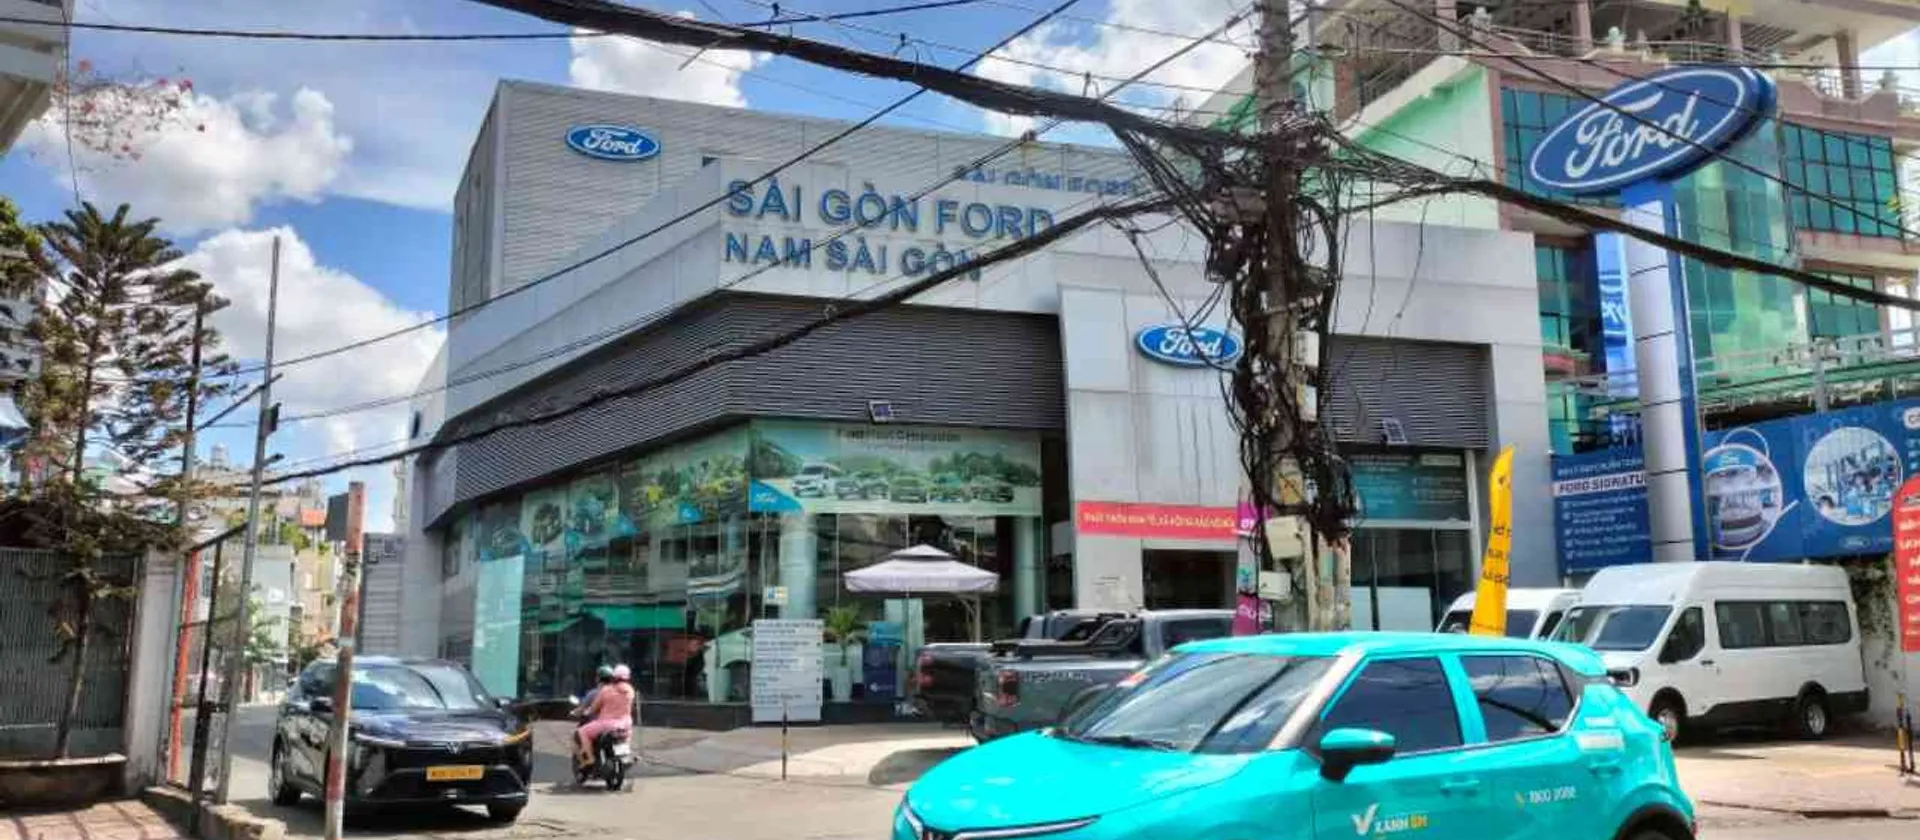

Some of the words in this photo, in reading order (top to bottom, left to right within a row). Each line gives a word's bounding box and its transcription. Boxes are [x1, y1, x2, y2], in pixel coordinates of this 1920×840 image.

[583, 129, 640, 154] Ford
[1564, 91, 1699, 178] Ford
[728, 176, 801, 222] SÀI
[818, 180, 918, 233] GÒN
[935, 198, 1055, 242] FORD
[724, 232, 812, 270] NAM
[825, 234, 888, 275] SÀI
[901, 241, 982, 284] GÒN
[1160, 328, 1220, 356] Ford
